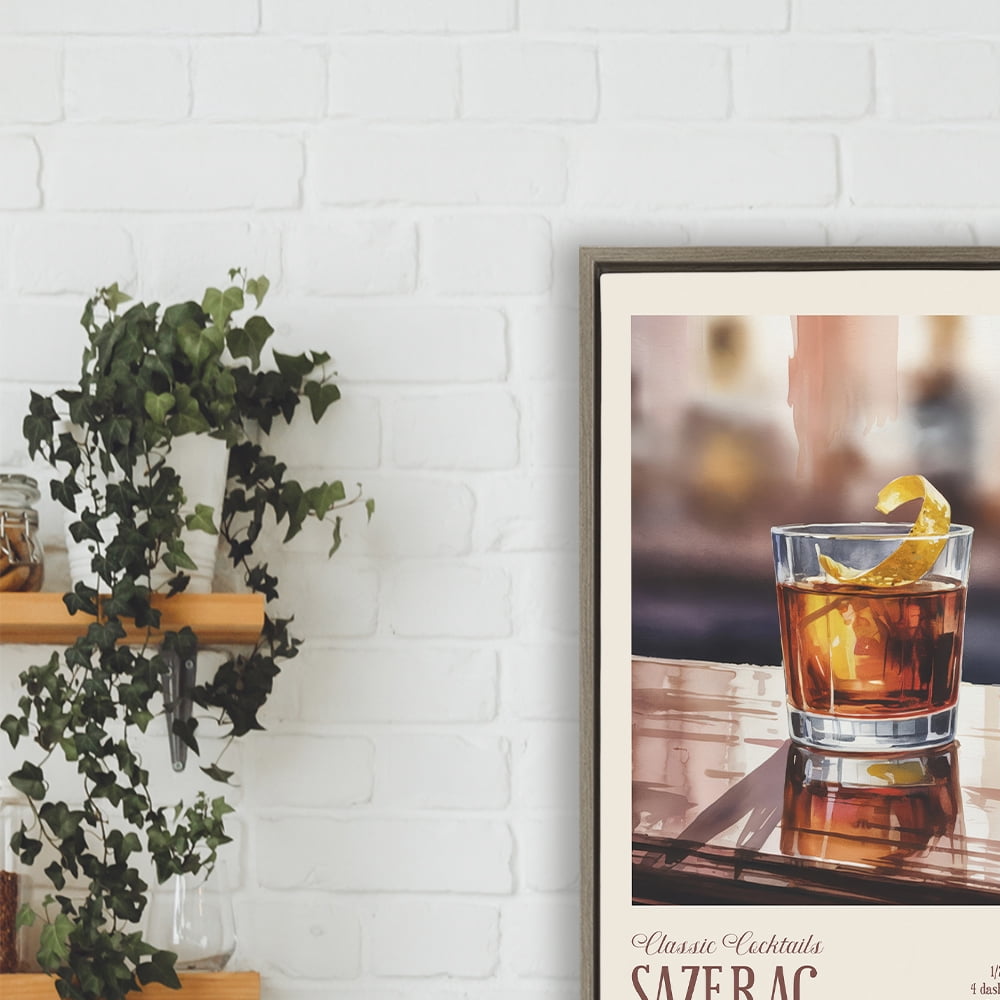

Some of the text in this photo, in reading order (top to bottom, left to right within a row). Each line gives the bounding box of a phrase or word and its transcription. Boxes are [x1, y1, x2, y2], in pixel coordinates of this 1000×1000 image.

[631, 930, 824, 955] Classic Cocktails
[970, 982, 977, 995] 4
